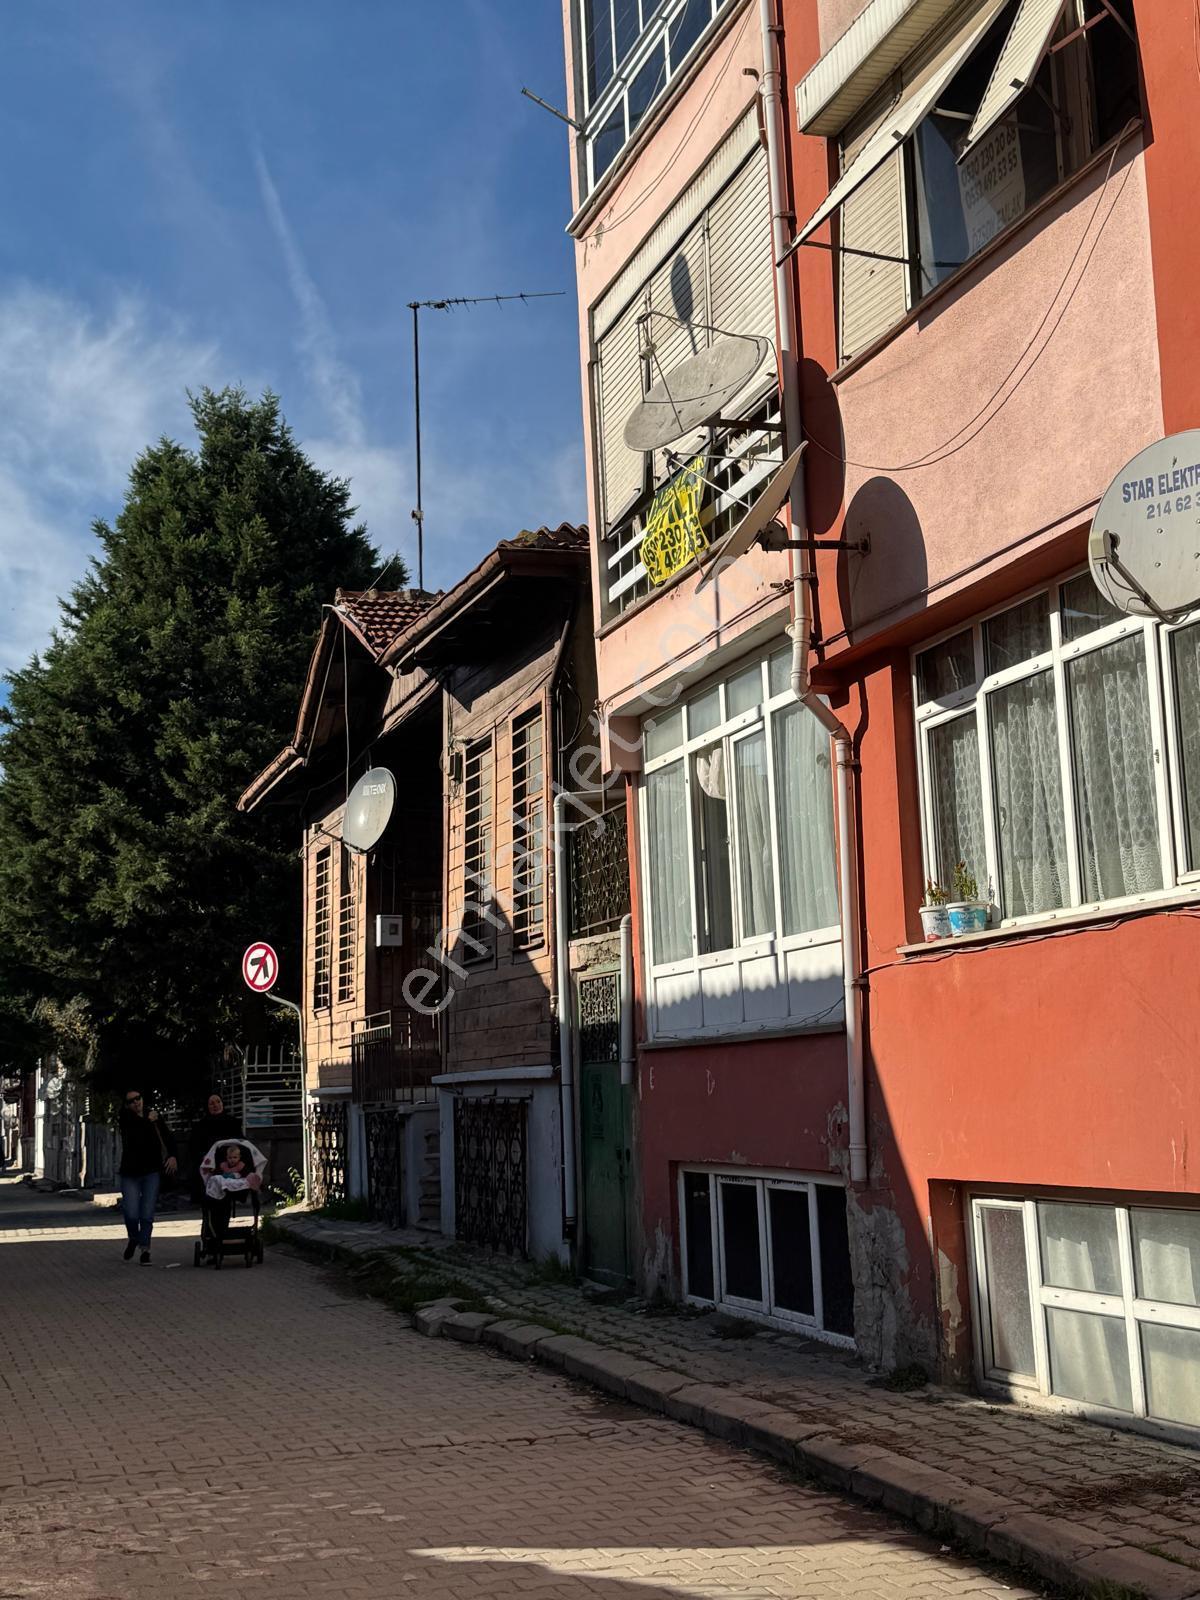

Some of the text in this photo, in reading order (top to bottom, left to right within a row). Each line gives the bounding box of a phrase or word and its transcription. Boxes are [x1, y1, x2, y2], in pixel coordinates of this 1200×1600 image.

[980, 143, 994, 171] 230
[995, 131, 1006, 155] 20
[1007, 146, 1018, 172] 55
[1122, 477, 1154, 504] STAR
[1146, 500, 1172, 520] 214
[1175, 494, 1192, 513] 62
[659, 524, 682, 551] 230
